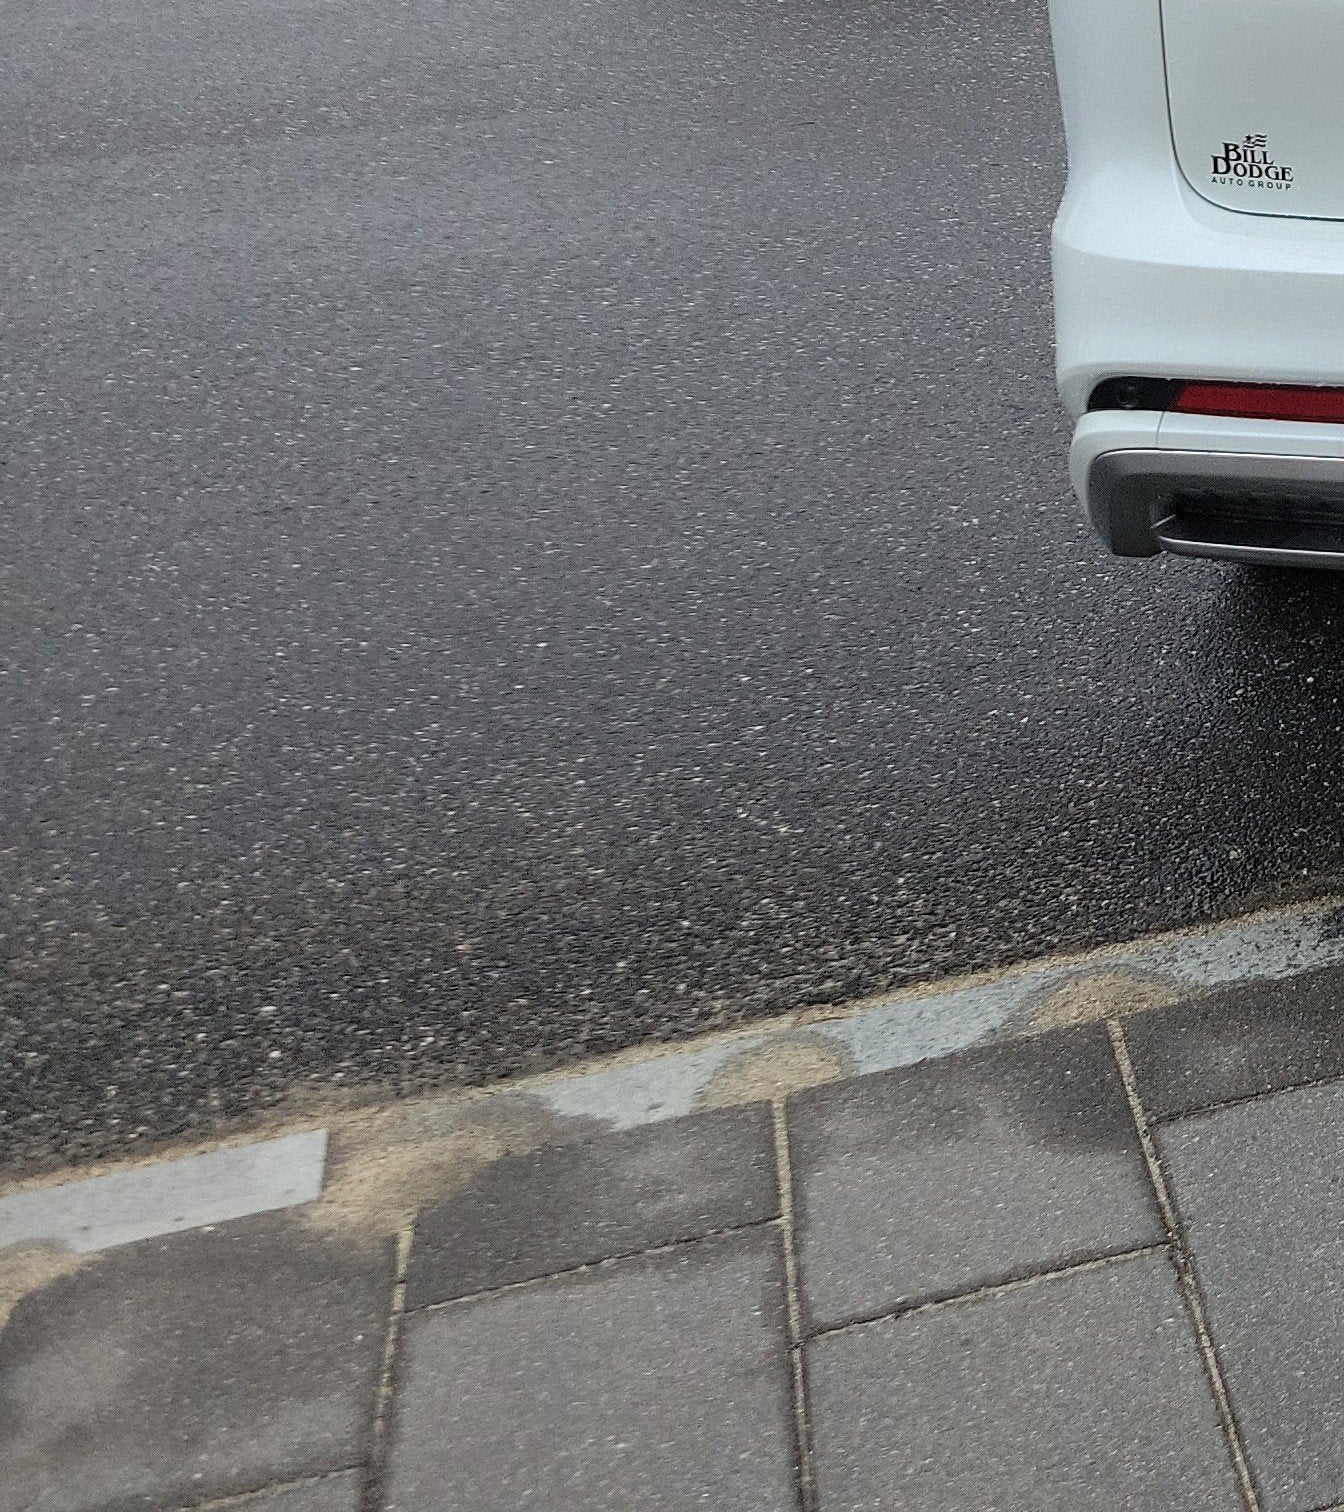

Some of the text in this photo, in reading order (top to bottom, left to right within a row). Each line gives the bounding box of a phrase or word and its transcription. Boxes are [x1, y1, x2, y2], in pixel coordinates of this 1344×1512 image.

[1222, 141, 1275, 164] BILL
[1211, 155, 1294, 182] DODGE
[1211, 176, 1292, 190] AUTO GROUP
